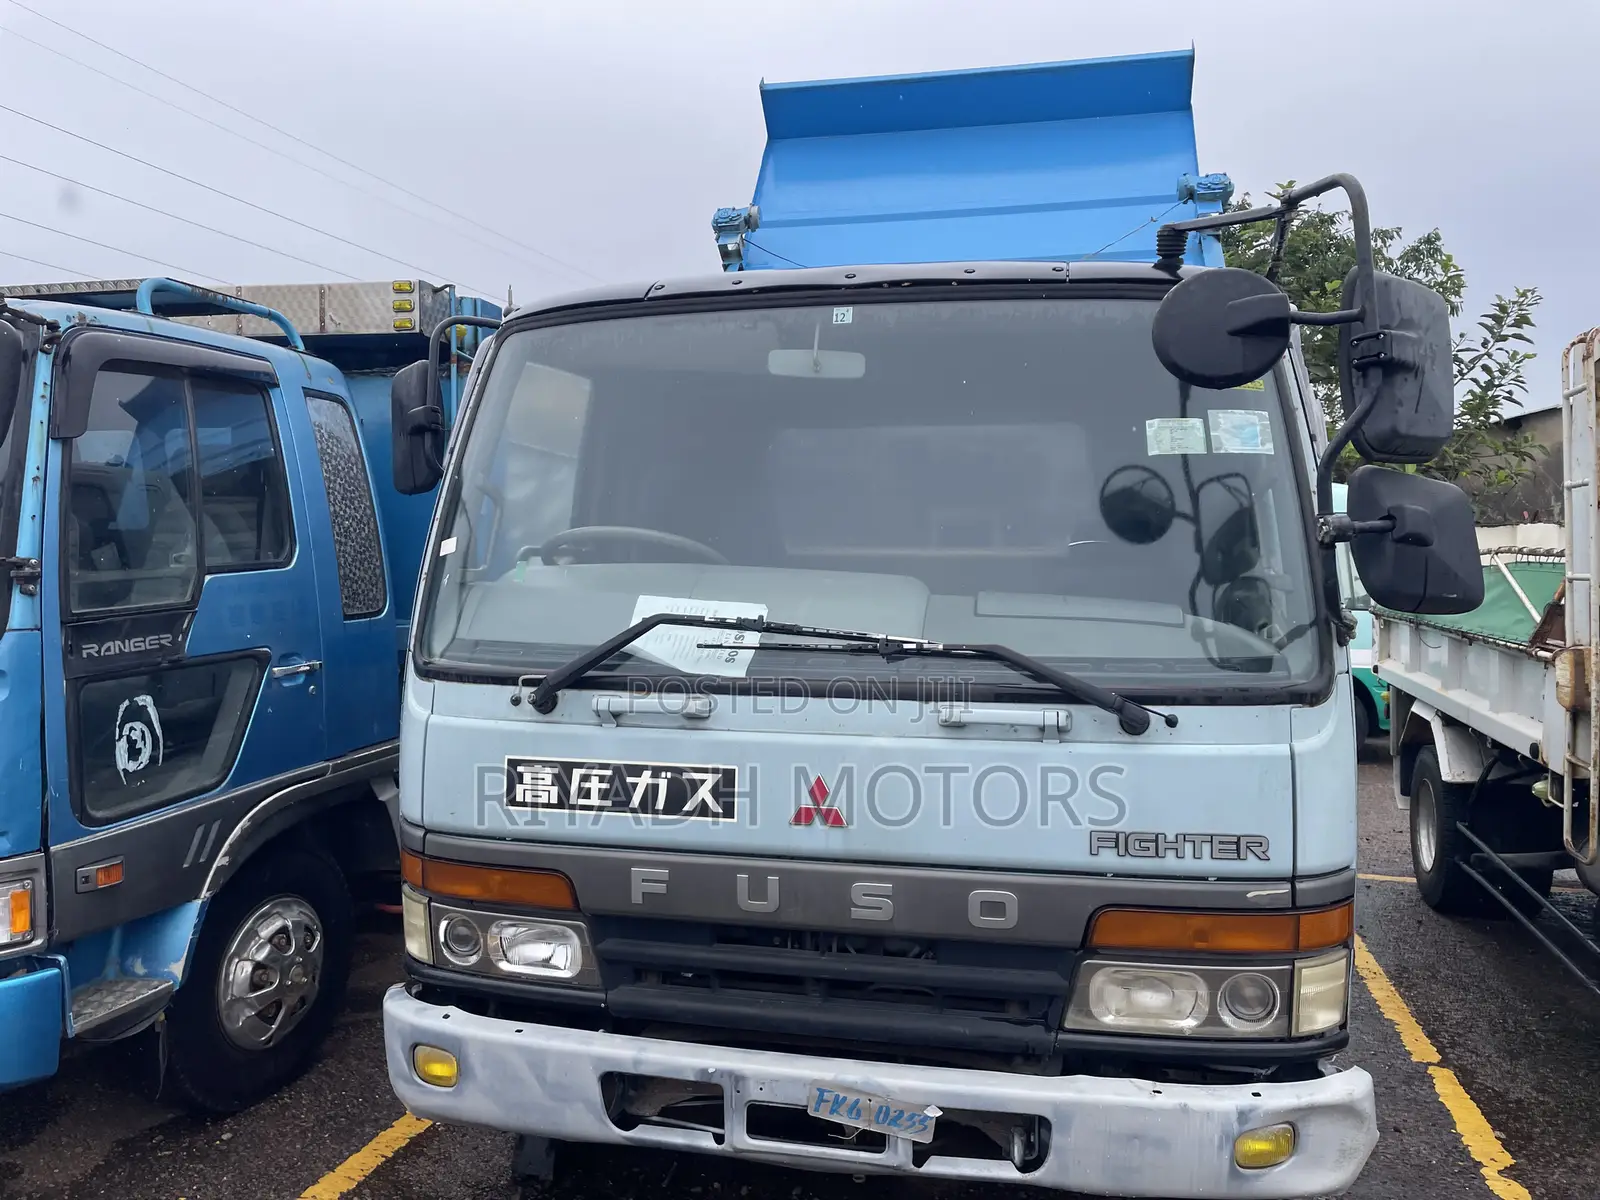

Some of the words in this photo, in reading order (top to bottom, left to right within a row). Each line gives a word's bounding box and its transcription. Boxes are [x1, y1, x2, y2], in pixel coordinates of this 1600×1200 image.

[834, 312, 846, 323] 12
[82, 633, 173, 658] RANGER
[515, 764, 724, 813] 高圧ガス
[1090, 831, 1270, 860] FIGHTER
[630, 867, 1019, 929] FUSO
[813, 1087, 862, 1121] FK6
